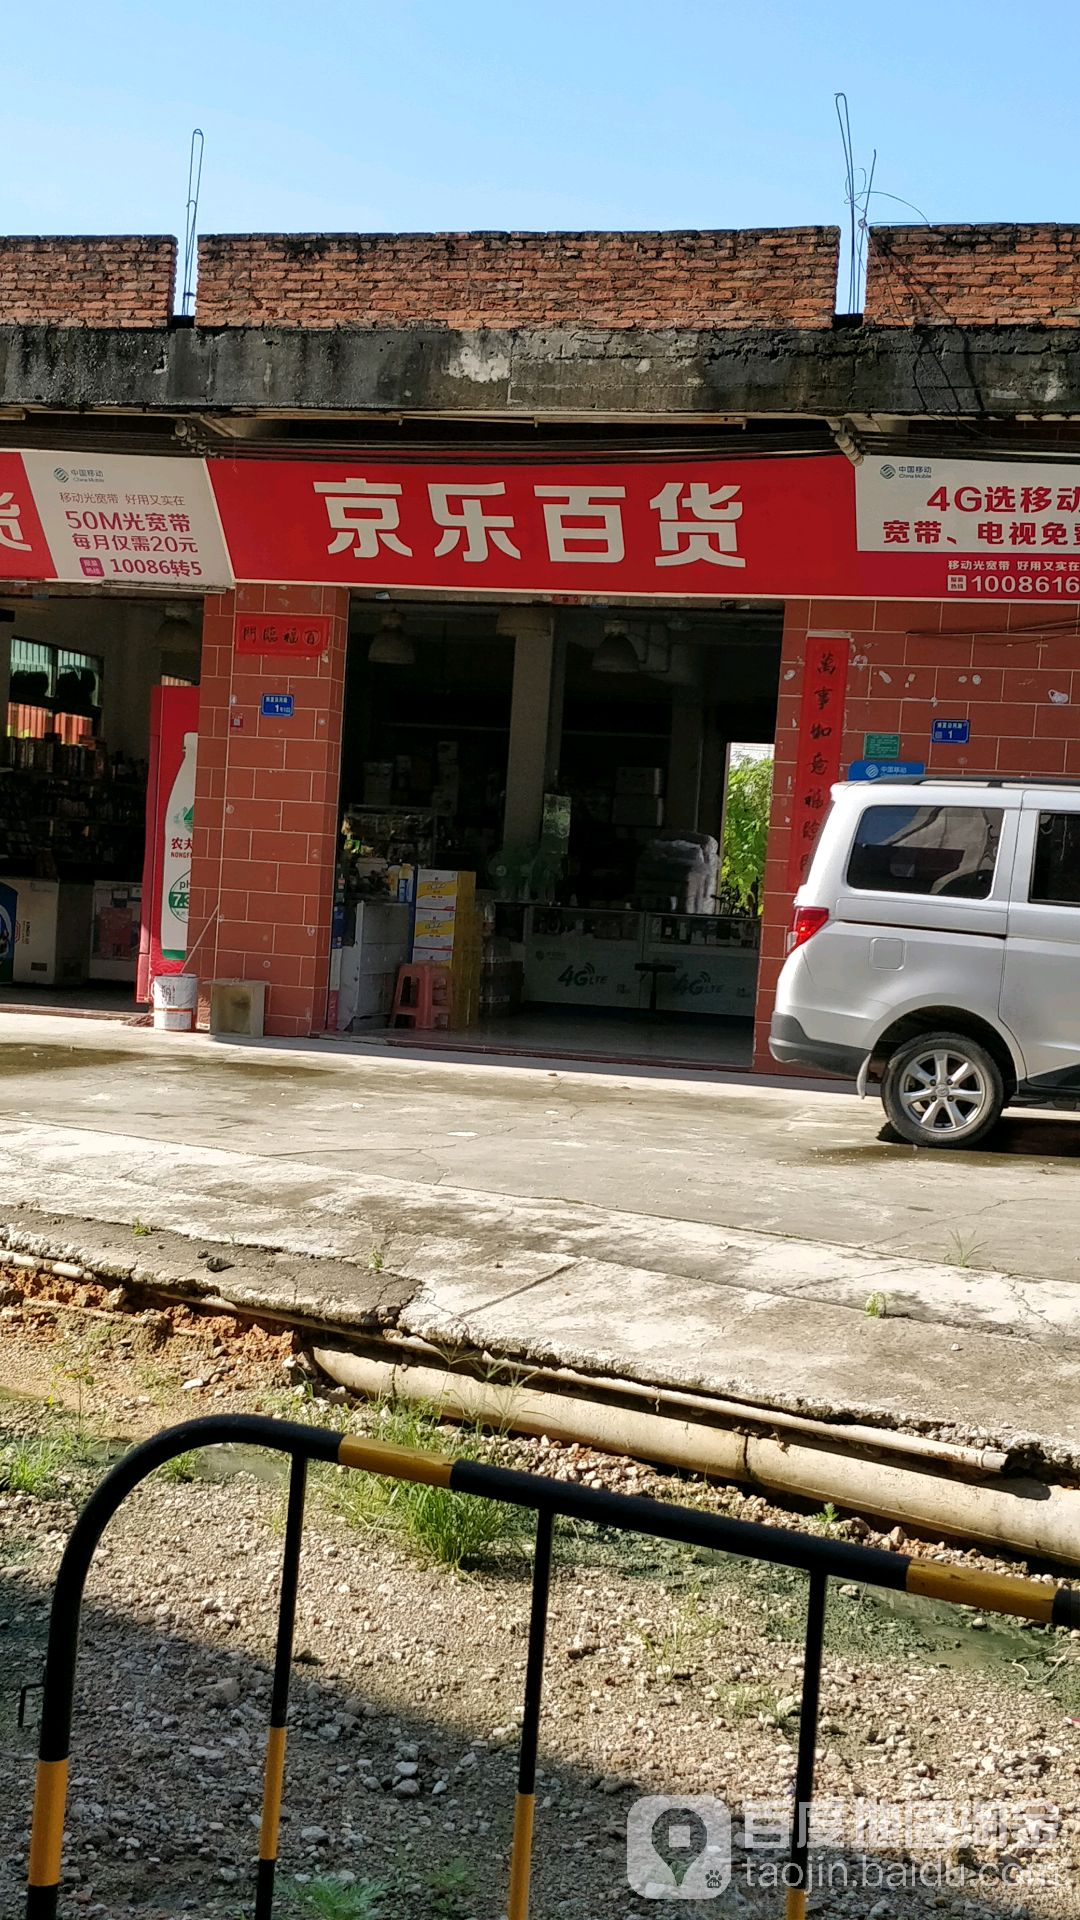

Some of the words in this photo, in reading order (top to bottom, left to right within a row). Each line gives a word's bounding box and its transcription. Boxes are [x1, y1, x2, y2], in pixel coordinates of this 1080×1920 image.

[71, 469, 104, 478] 中国移动
[899, 465, 932, 474] 中国移动
[59, 491, 119, 504] 移动光宽带
[125, 493, 186, 506] 好用又实在
[926, 486, 1080, 513] 4G选移动
[65, 510, 191, 533] 50M光宽带
[313, 477, 747, 568] 京乐百货
[883, 520, 1080, 546] 宽带、电视免
[72, 533, 199, 553] 每月仅需20元
[110, 558, 203, 577] 10086转5
[947, 560, 1010, 571] 移动光宽带
[1016, 560, 1080, 572] 好用又实在
[971, 575, 1080, 593] 1008616
